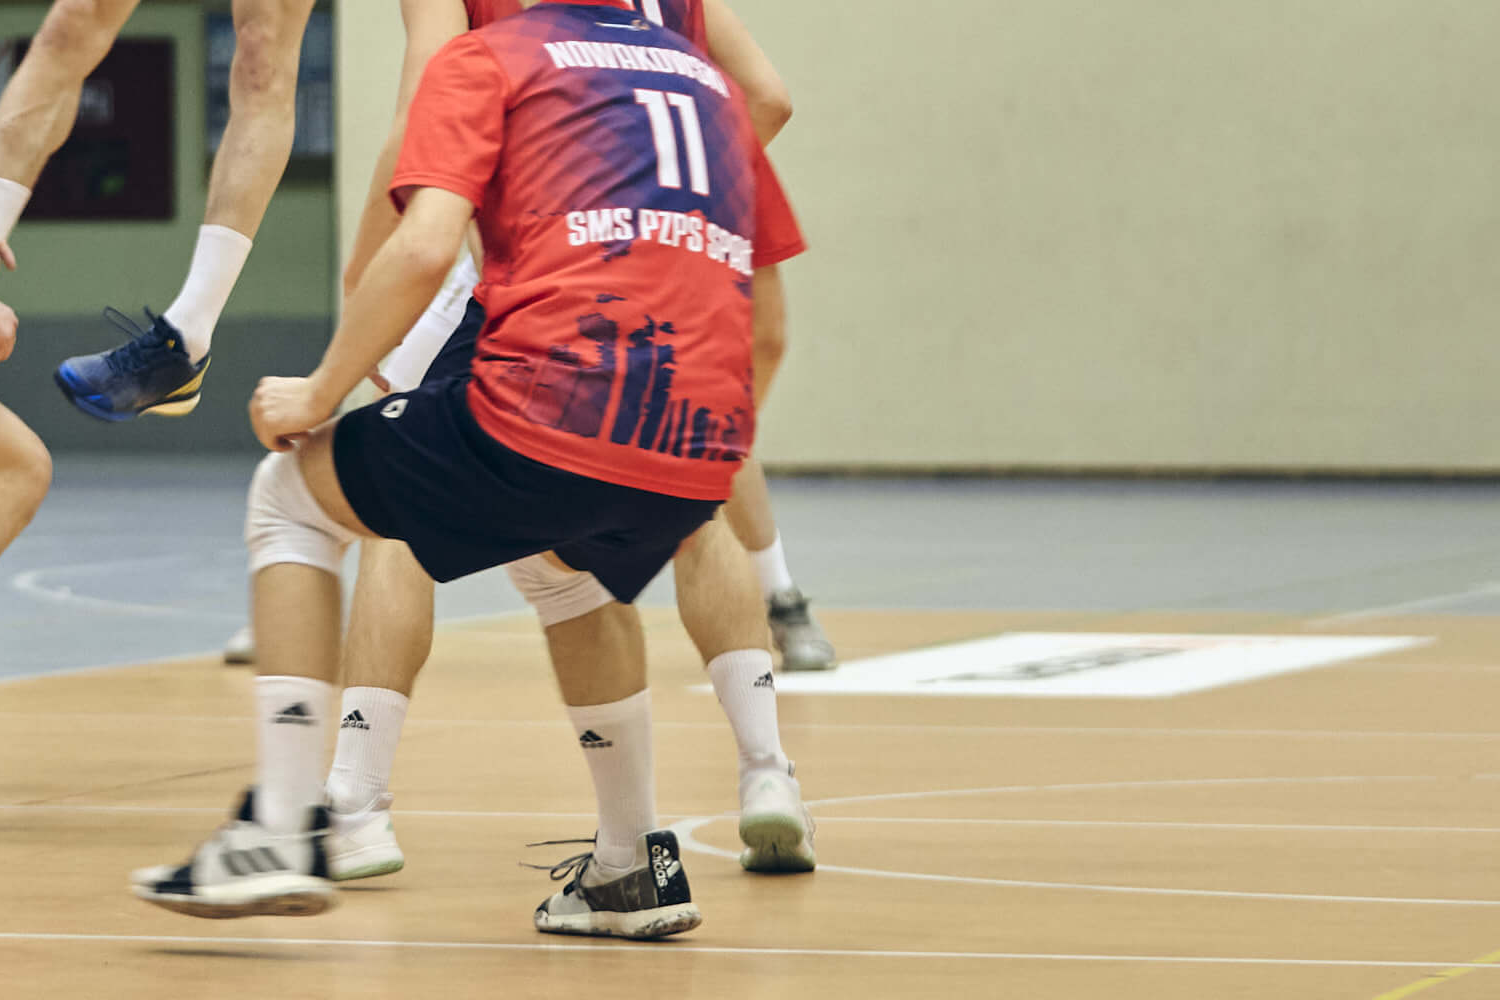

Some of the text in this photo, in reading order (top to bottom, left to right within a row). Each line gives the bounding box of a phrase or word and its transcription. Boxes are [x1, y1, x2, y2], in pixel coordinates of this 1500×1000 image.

[633, 87, 710, 197] 11
[565, 207, 635, 247] SMS
[638, 209, 704, 253] PZPS
[651, 844, 669, 888] adidas
